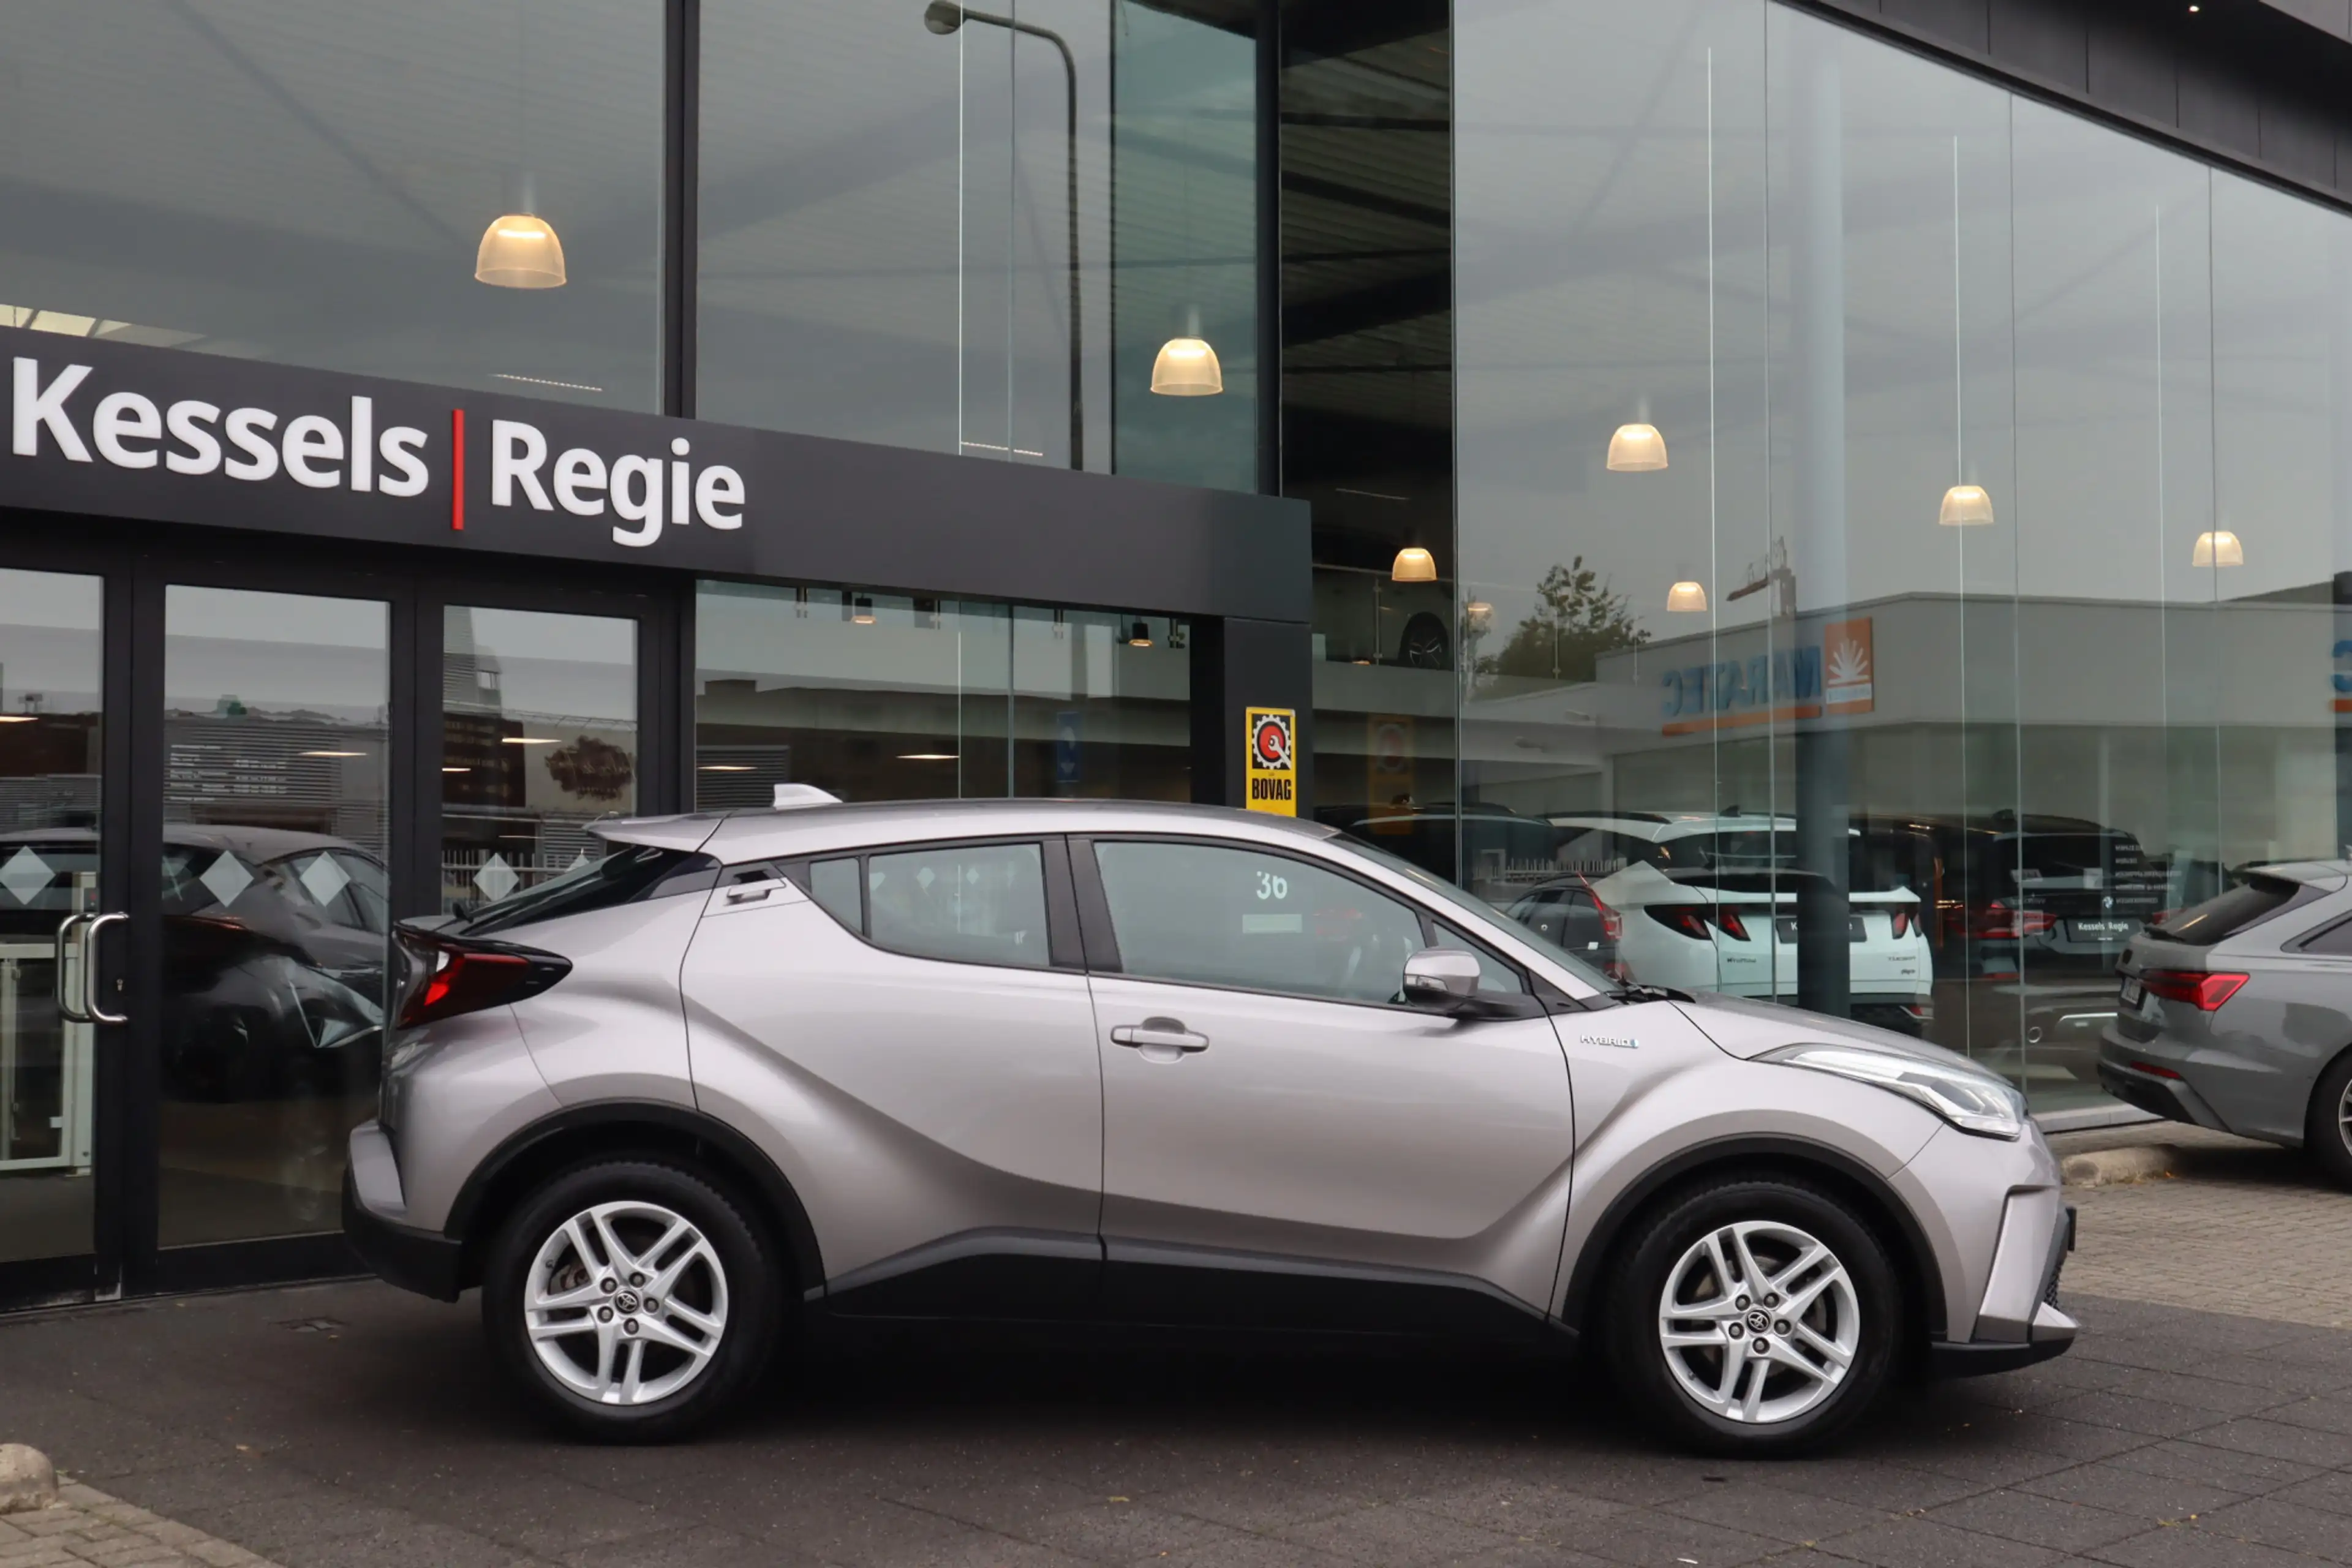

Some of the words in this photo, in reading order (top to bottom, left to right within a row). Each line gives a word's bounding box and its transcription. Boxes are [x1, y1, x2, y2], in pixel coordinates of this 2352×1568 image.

[12, 356, 429, 498] Kessels
[491, 419, 745, 548] Regie
[1251, 778, 1292, 801] BOVAG
[2077, 921, 2105, 931] Kessels
[1580, 1034, 1630, 1047] HYBRID
